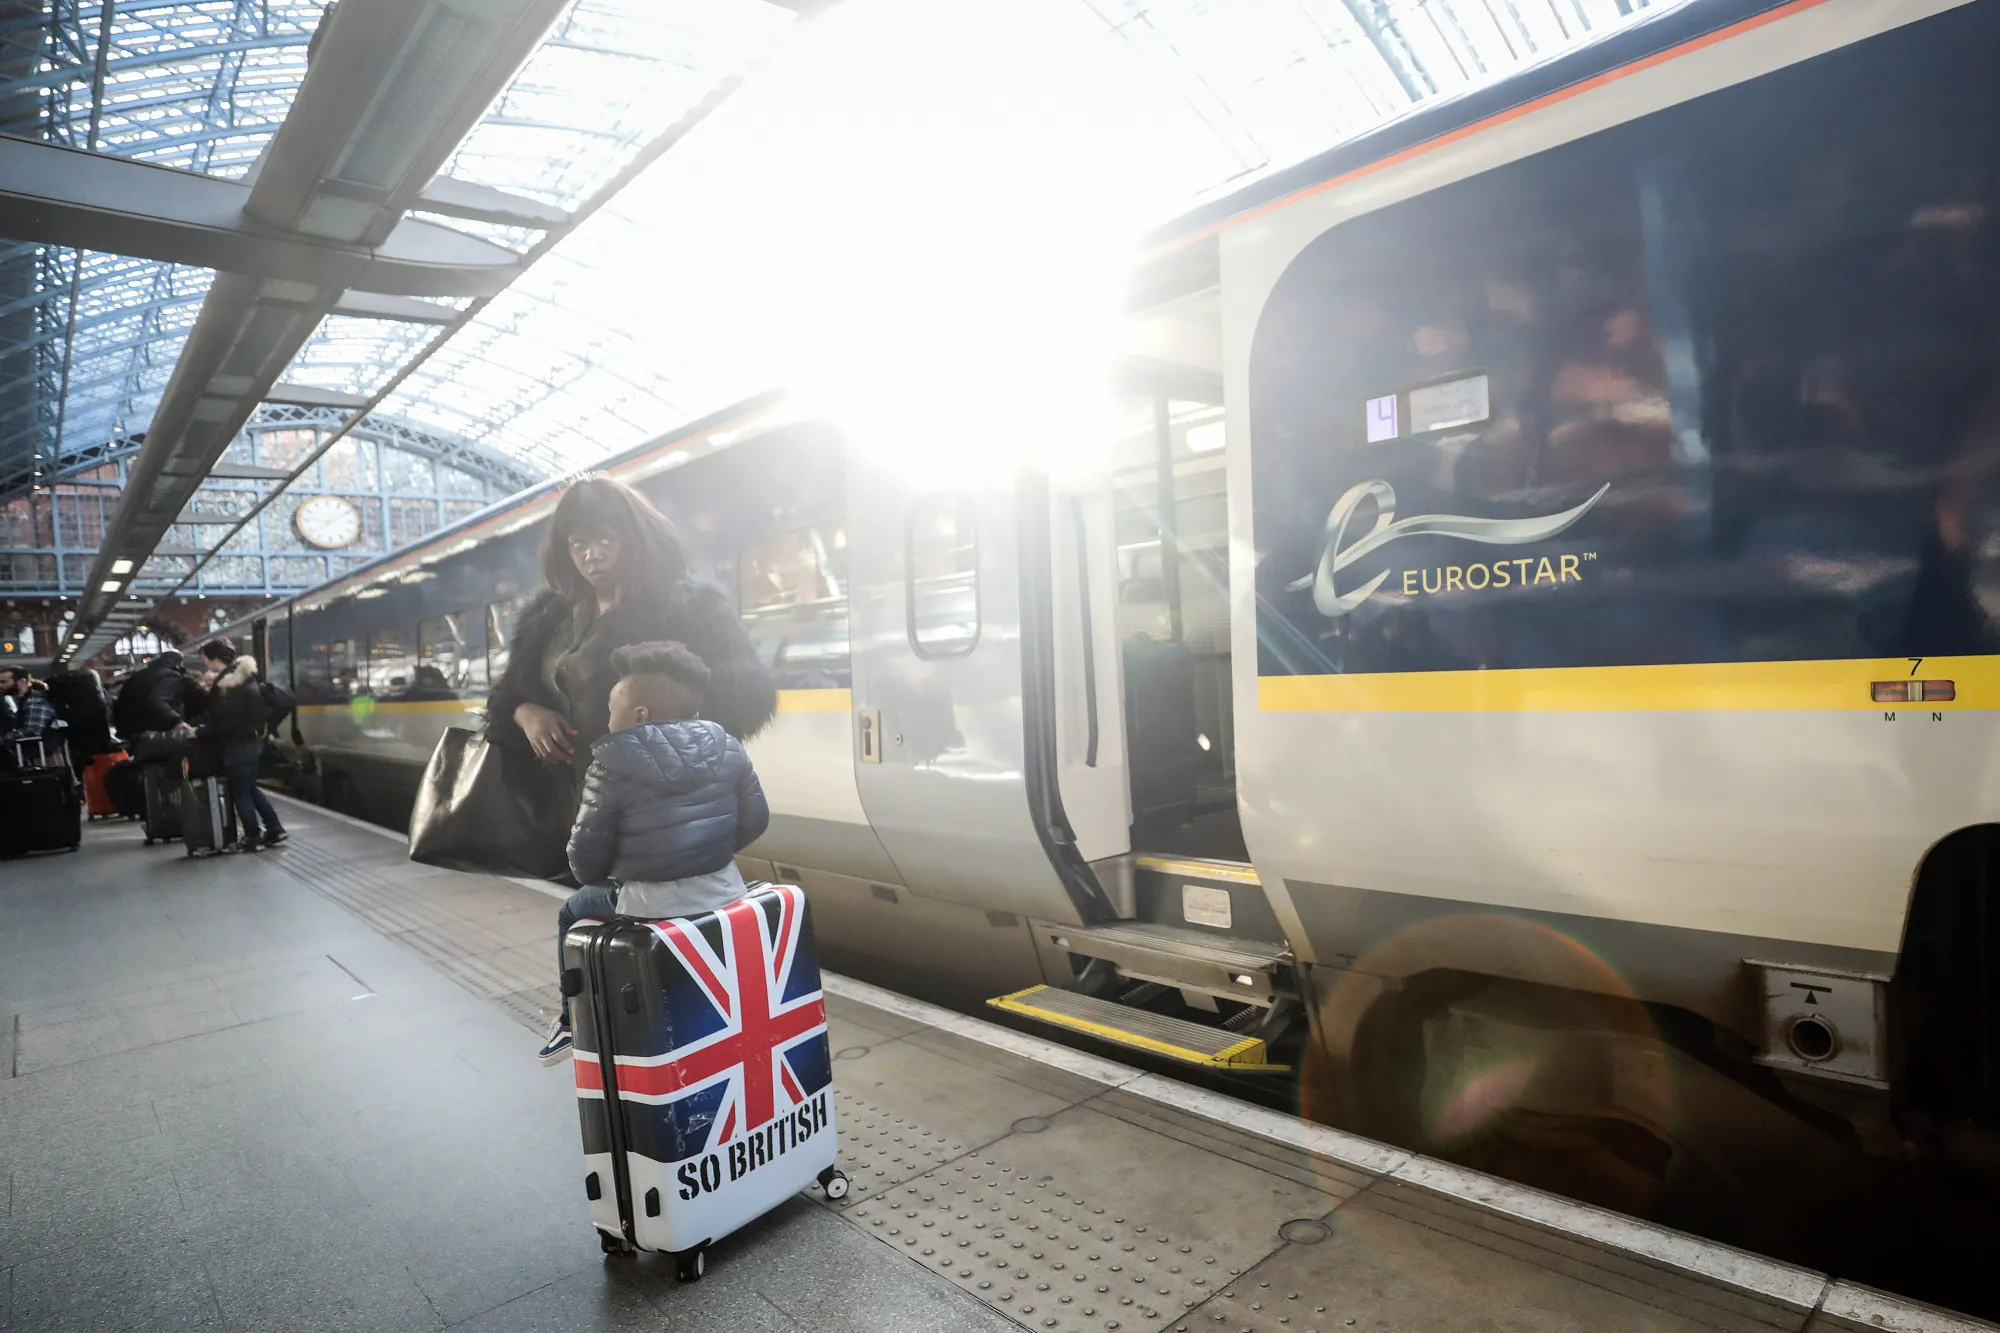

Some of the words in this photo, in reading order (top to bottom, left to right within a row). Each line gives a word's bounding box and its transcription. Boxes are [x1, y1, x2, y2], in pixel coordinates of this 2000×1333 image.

[1378, 396, 1396, 437] 4
[1908, 658, 1923, 676] 7
[1884, 712, 1896, 722] M
[1932, 712, 1942, 722] N
[677, 1153, 721, 1200] SO
[728, 1092, 828, 1182] BRITISH
